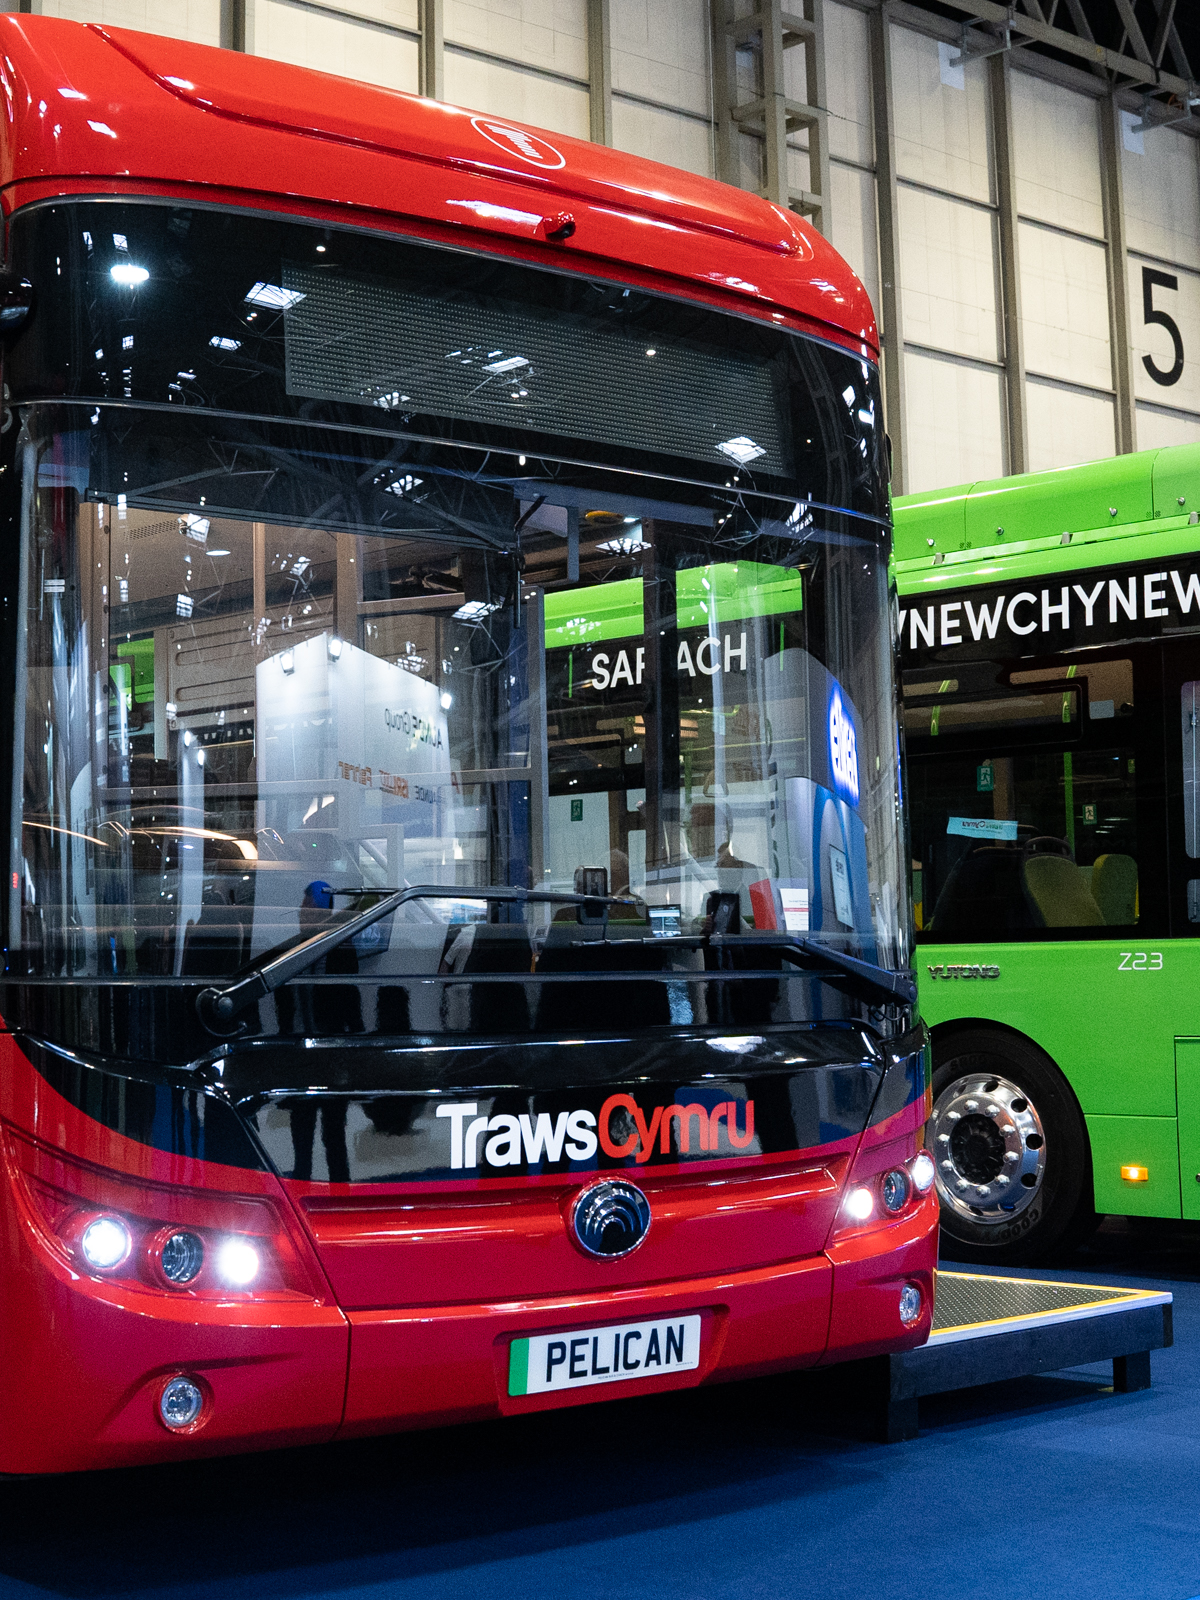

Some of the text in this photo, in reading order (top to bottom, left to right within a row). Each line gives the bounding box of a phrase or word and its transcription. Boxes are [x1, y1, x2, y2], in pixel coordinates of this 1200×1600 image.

[1142, 265, 1184, 387] 5
[899, 571, 1200, 650] NEWCHYNEW
[927, 964, 1000, 980] YUTONG
[1117, 952, 1164, 971] Z23
[436, 1093, 755, 1169] TrawsCymru
[546, 1324, 685, 1383] PELICAN
